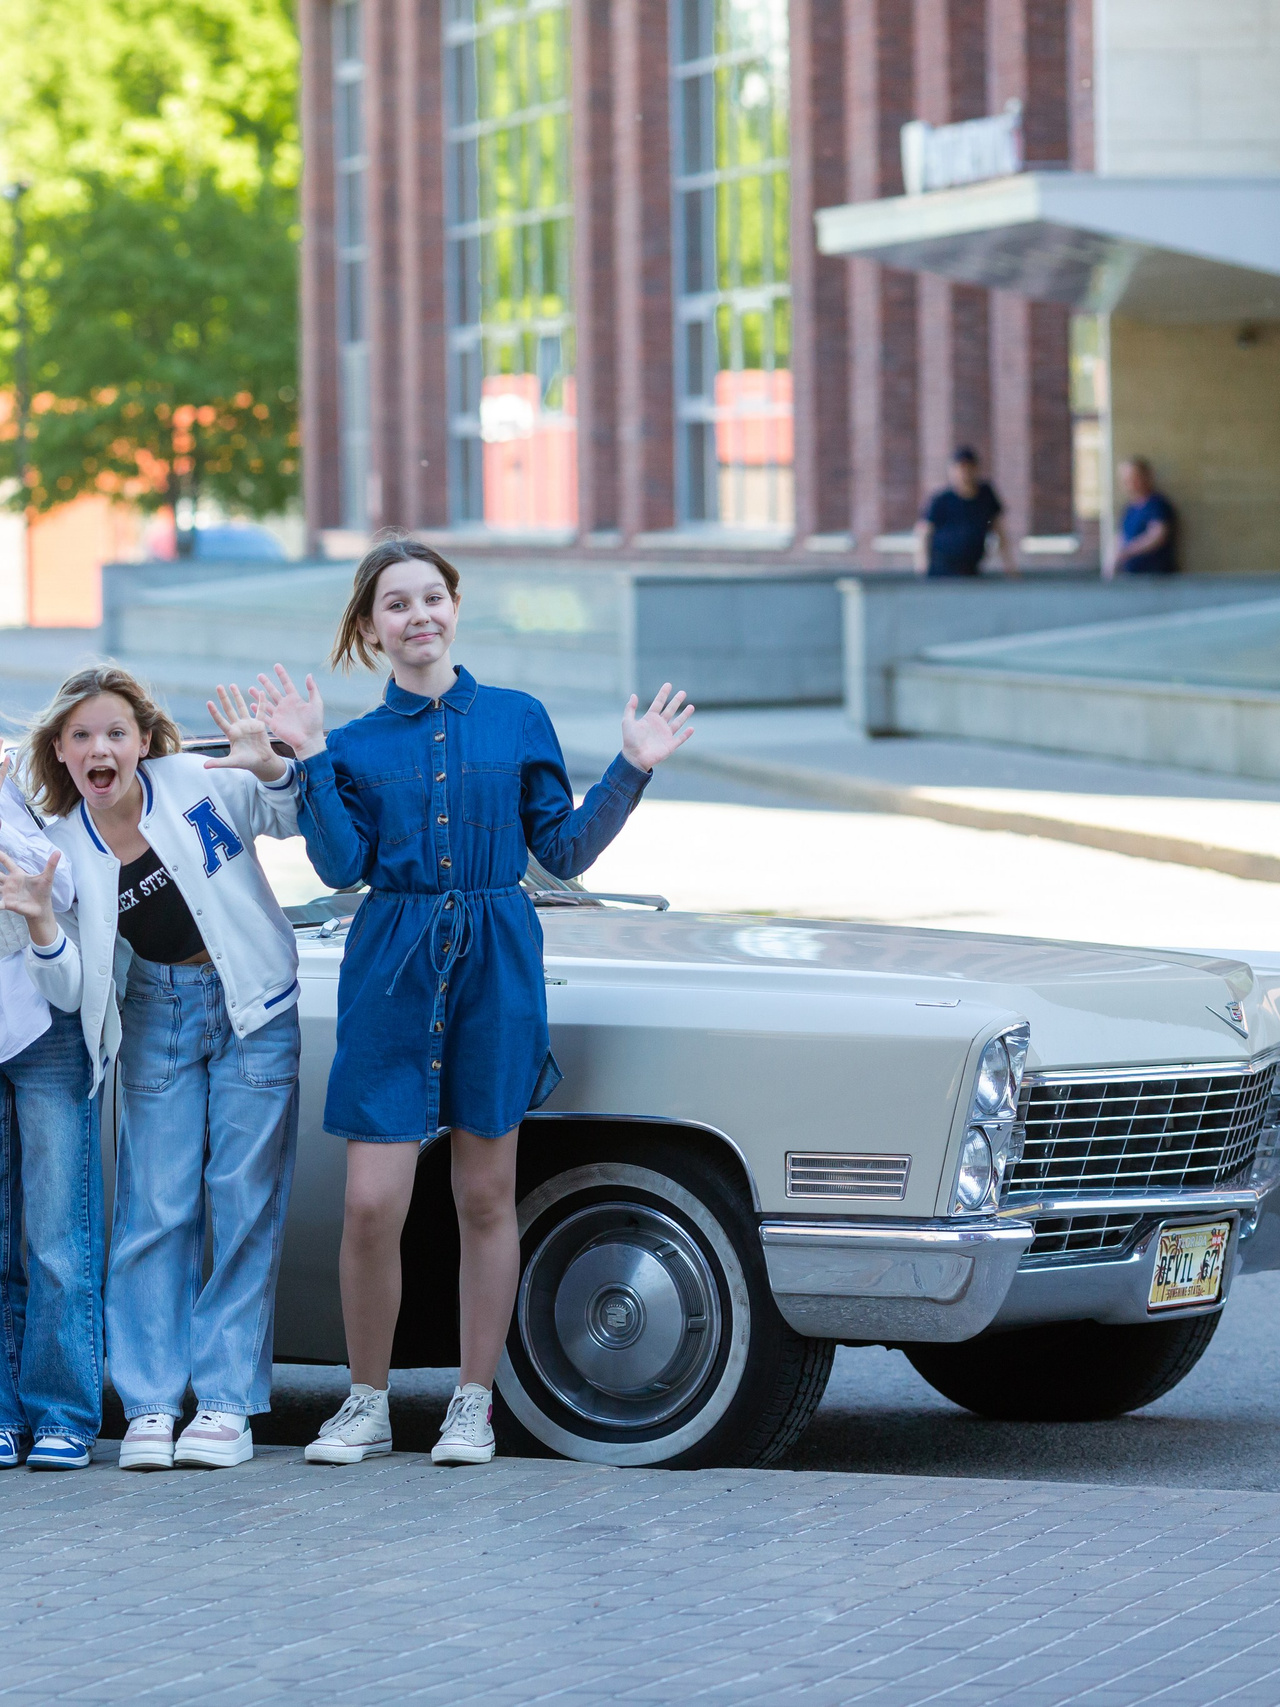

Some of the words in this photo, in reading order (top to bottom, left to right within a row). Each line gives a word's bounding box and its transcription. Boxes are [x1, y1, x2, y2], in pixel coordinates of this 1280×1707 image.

[118, 888, 140, 913] EX
[1177, 1235, 1207, 1249] FLORIDA
[1201, 1250, 1218, 1280] 67
[1167, 1286, 1188, 1298] SUNSHINE
[1188, 1285, 1201, 1295] STATE
